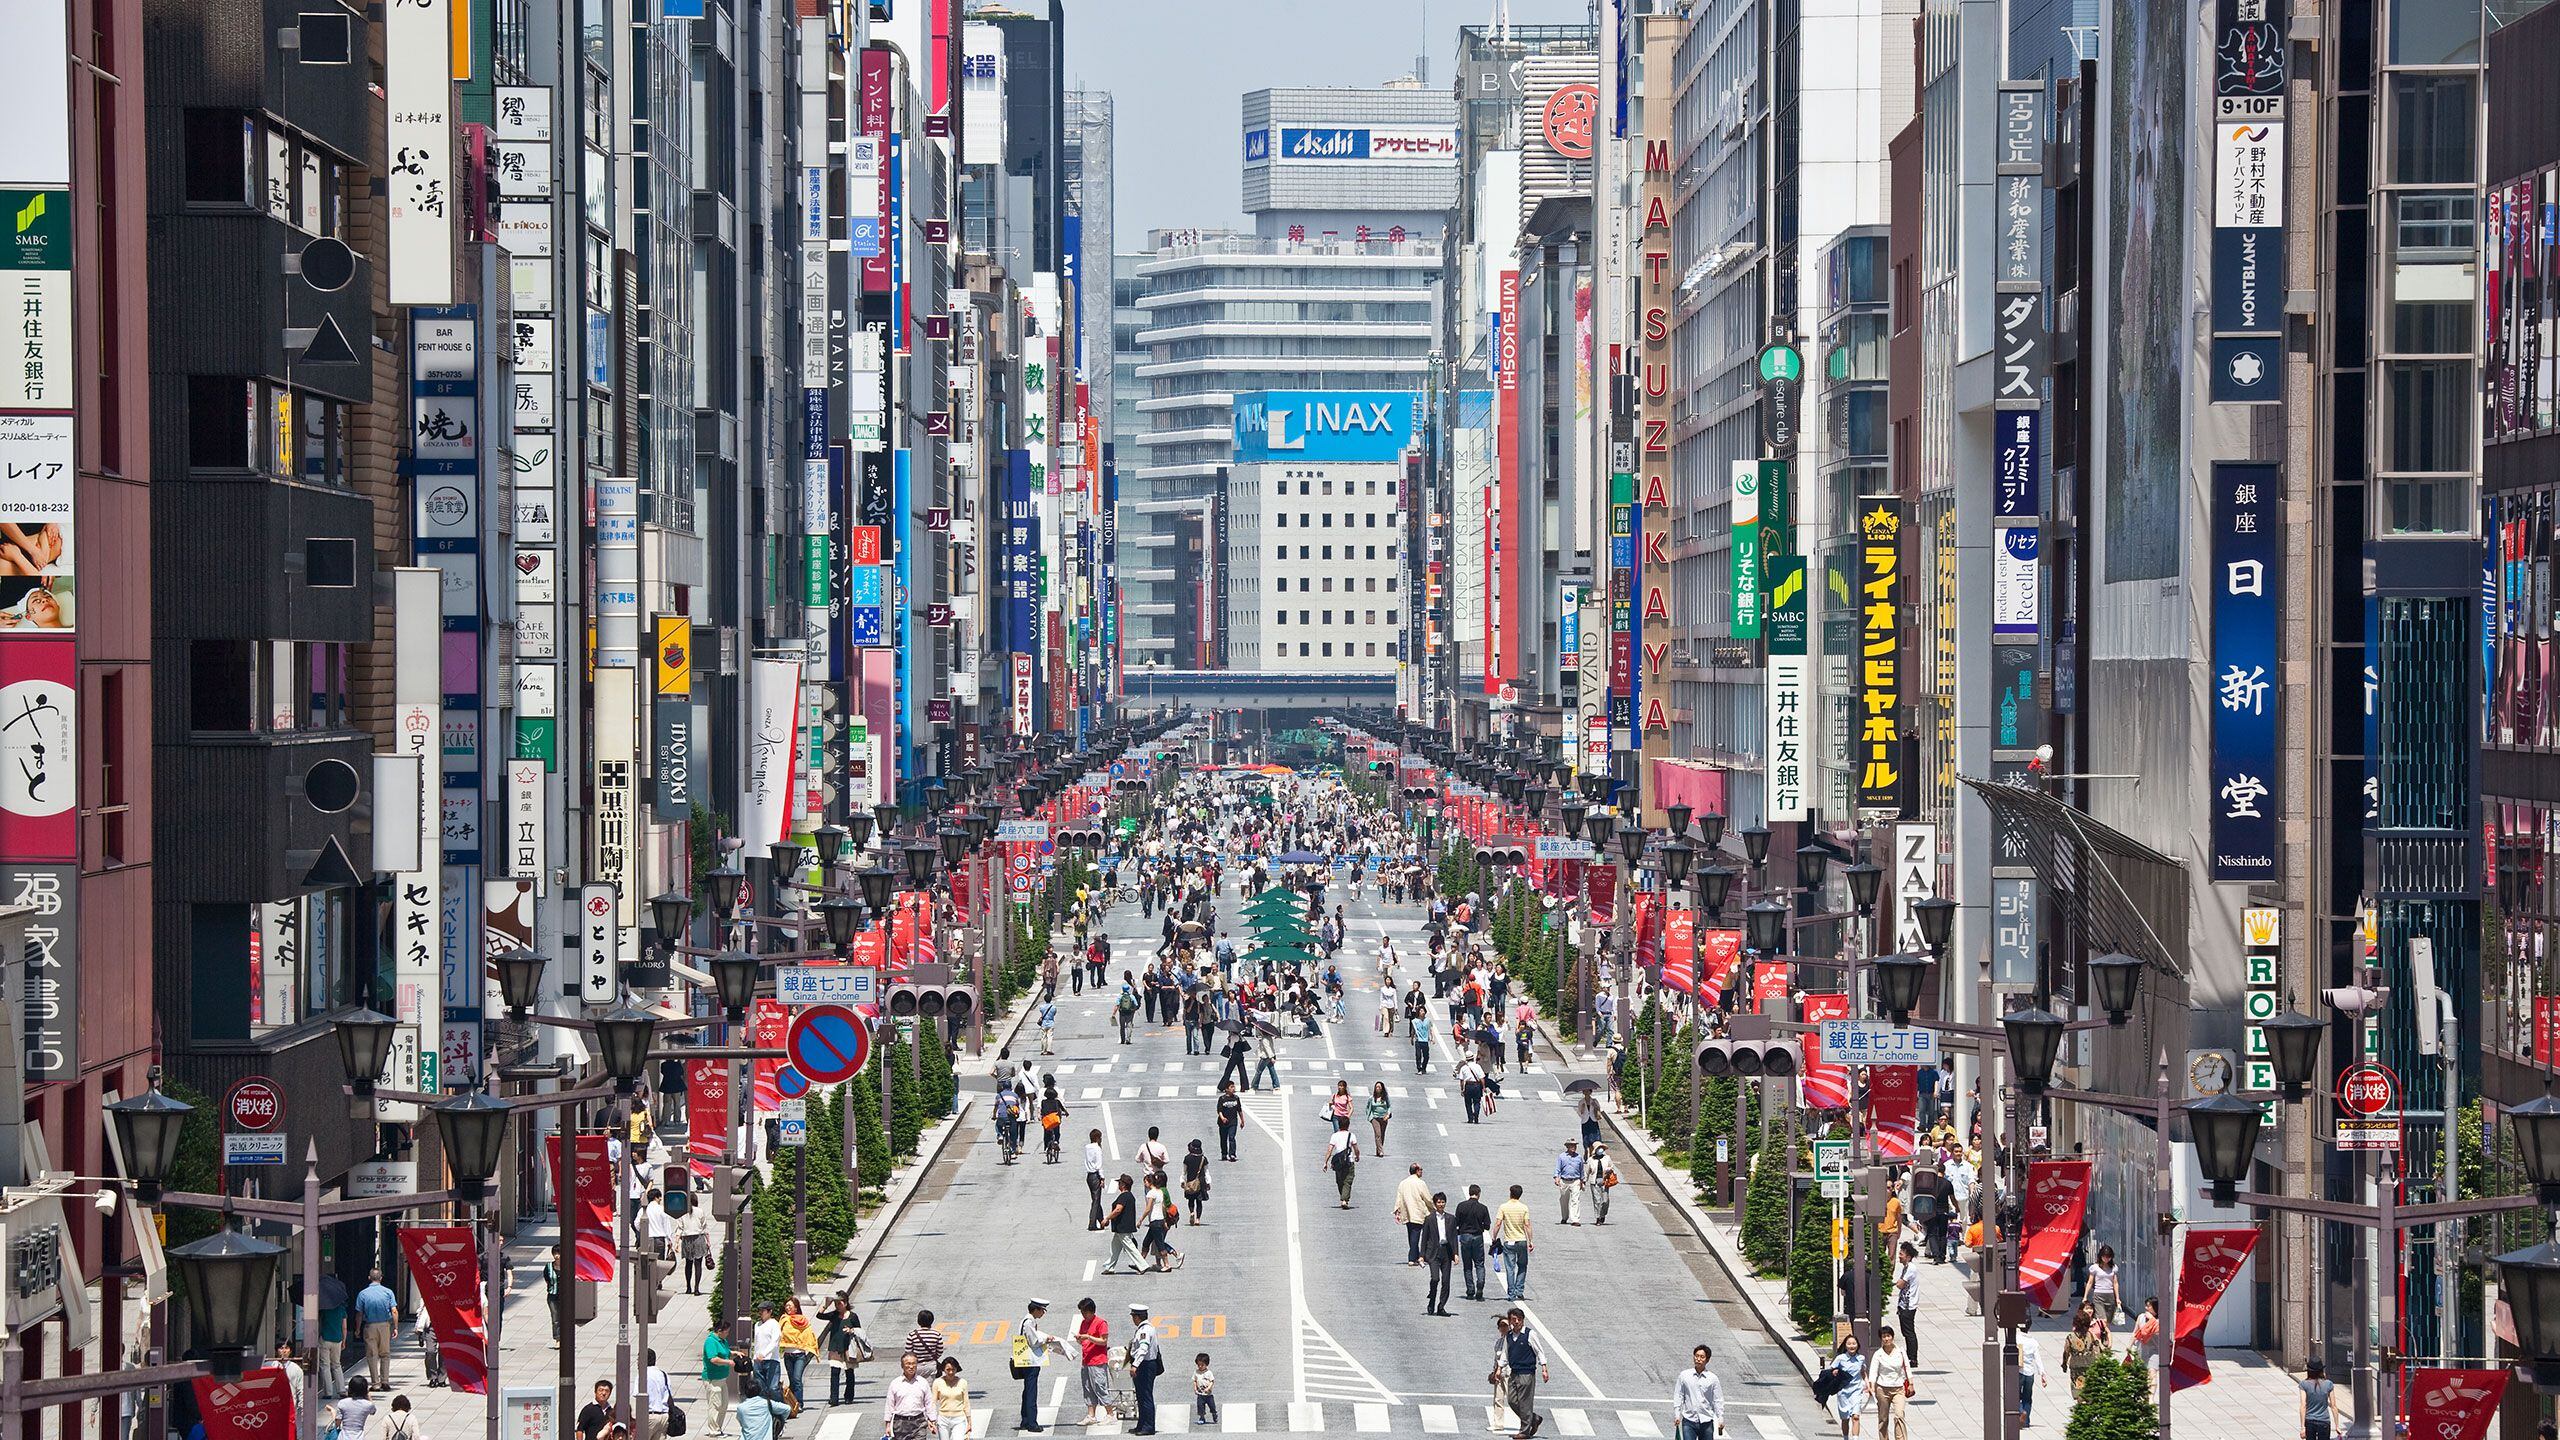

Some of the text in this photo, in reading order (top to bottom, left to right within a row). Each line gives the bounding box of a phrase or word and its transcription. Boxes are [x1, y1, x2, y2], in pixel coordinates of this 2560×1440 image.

[394, 112, 443, 125] 日本料理
[537, 130, 549, 138] 11F
[1293, 129, 1355, 156] Asahi
[1373, 137, 1453, 153] アサヒビール
[537, 185, 549, 193] 10F
[2233, 147, 2246, 225] アーバンネット
[2249, 147, 2266, 225] 野村不動産
[808, 168, 822, 237] 銀座通り法律事務所
[1288, 224, 1406, 243] 第一生命
[2007, 177, 2032, 262] 新和産業
[15, 235, 48, 246] SMBC
[539, 246, 549, 254] 9F
[2006, 263, 2031, 278] (株)
[2242, 232, 2257, 327] MONTBLANC
[539, 302, 548, 310] 8F
[23, 277, 44, 400] 三井住友銀行
[436, 328, 453, 337] BAR
[806, 271, 826, 379] 企画通信社
[866, 321, 887, 334] 6F
[1502, 278, 1516, 391] MITSUKOSHI
[1776, 326, 1784, 336] 5
[417, 343, 472, 352] PENT HOUSE G
[962, 324, 975, 360] 大黒屋
[2000, 295, 2038, 396] ダンス
[427, 370, 462, 379] 3571-0735
[437, 384, 453, 394] 8F
[0, 418, 35, 426] メディカル
[541, 416, 550, 425] 6F
[1024, 363, 1046, 490] 教文館
[1305, 402, 1393, 433] INAX
[1773, 379, 1789, 444] esquire club
[1644, 139, 1672, 731] MATSUZAKAYA
[7, 461, 64, 480] レイア
[438, 462, 454, 472] 7F
[2016, 415, 2031, 496] 銀座フェミー
[600, 486, 634, 495] UEMATSU
[2002, 448, 2016, 514] クリニック
[1, 503, 69, 513] 0120-018-232
[600, 498, 615, 507] BLD
[1218, 491, 1226, 545] INAX GINZA
[2234, 483, 2258, 535] 銀座
[541, 531, 551, 539] 4F
[1104, 508, 1113, 546] ALBION
[2007, 533, 2038, 551] リセラ
[439, 541, 454, 550] 6F
[1012, 500, 1028, 599] 山野楽器
[811, 536, 822, 604] 西銀座診療所
[1737, 542, 1755, 626] りそな銀行
[1999, 547, 2008, 623] medical esthe
[2016, 562, 2034, 622] Recella
[1771, 611, 1805, 623] SMBC
[810, 621, 828, 666] Ash
[1564, 615, 1575, 653] 新生銀行
[1078, 649, 1086, 687] ARTISAN
[1582, 631, 1599, 698] GINZA
[1617, 644, 1628, 683] ナカヤ
[1861, 546, 1899, 789] ライオンビヤホール
[2018, 670, 2032, 701] 銀座
[2219, 558, 2270, 820] 日新堂
[2, 694, 59, 803] やまと
[1776, 666, 1800, 811] 三井住友銀行
[520, 790, 533, 812] 銀座
[517, 821, 536, 877] 立田
[1539, 840, 1592, 851] 銀座六丁目
[1015, 859, 1027, 869] 50
[2217, 854, 2273, 869] Nisshindo
[403, 882, 432, 968] セキネ
[2018, 880, 2031, 960] カット&パーマ
[2000, 896, 2019, 979] シロー
[13, 873, 64, 1071] 福家書店
[591, 925, 607, 990] とらや
[783, 968, 811, 976] 中央区
[783, 975, 869, 992] 銀座七丁目
[792, 991, 860, 1001] Ginza 7-chome
[1828, 1021, 1861, 1031] 中央区
[1828, 1032, 1930, 1050] 銀座七丁目
[1838, 1050, 1919, 1061] Ginza 7-chome
[236, 1098, 274, 1115] 消火栓
[2349, 1083, 2387, 1100] 消火栓
